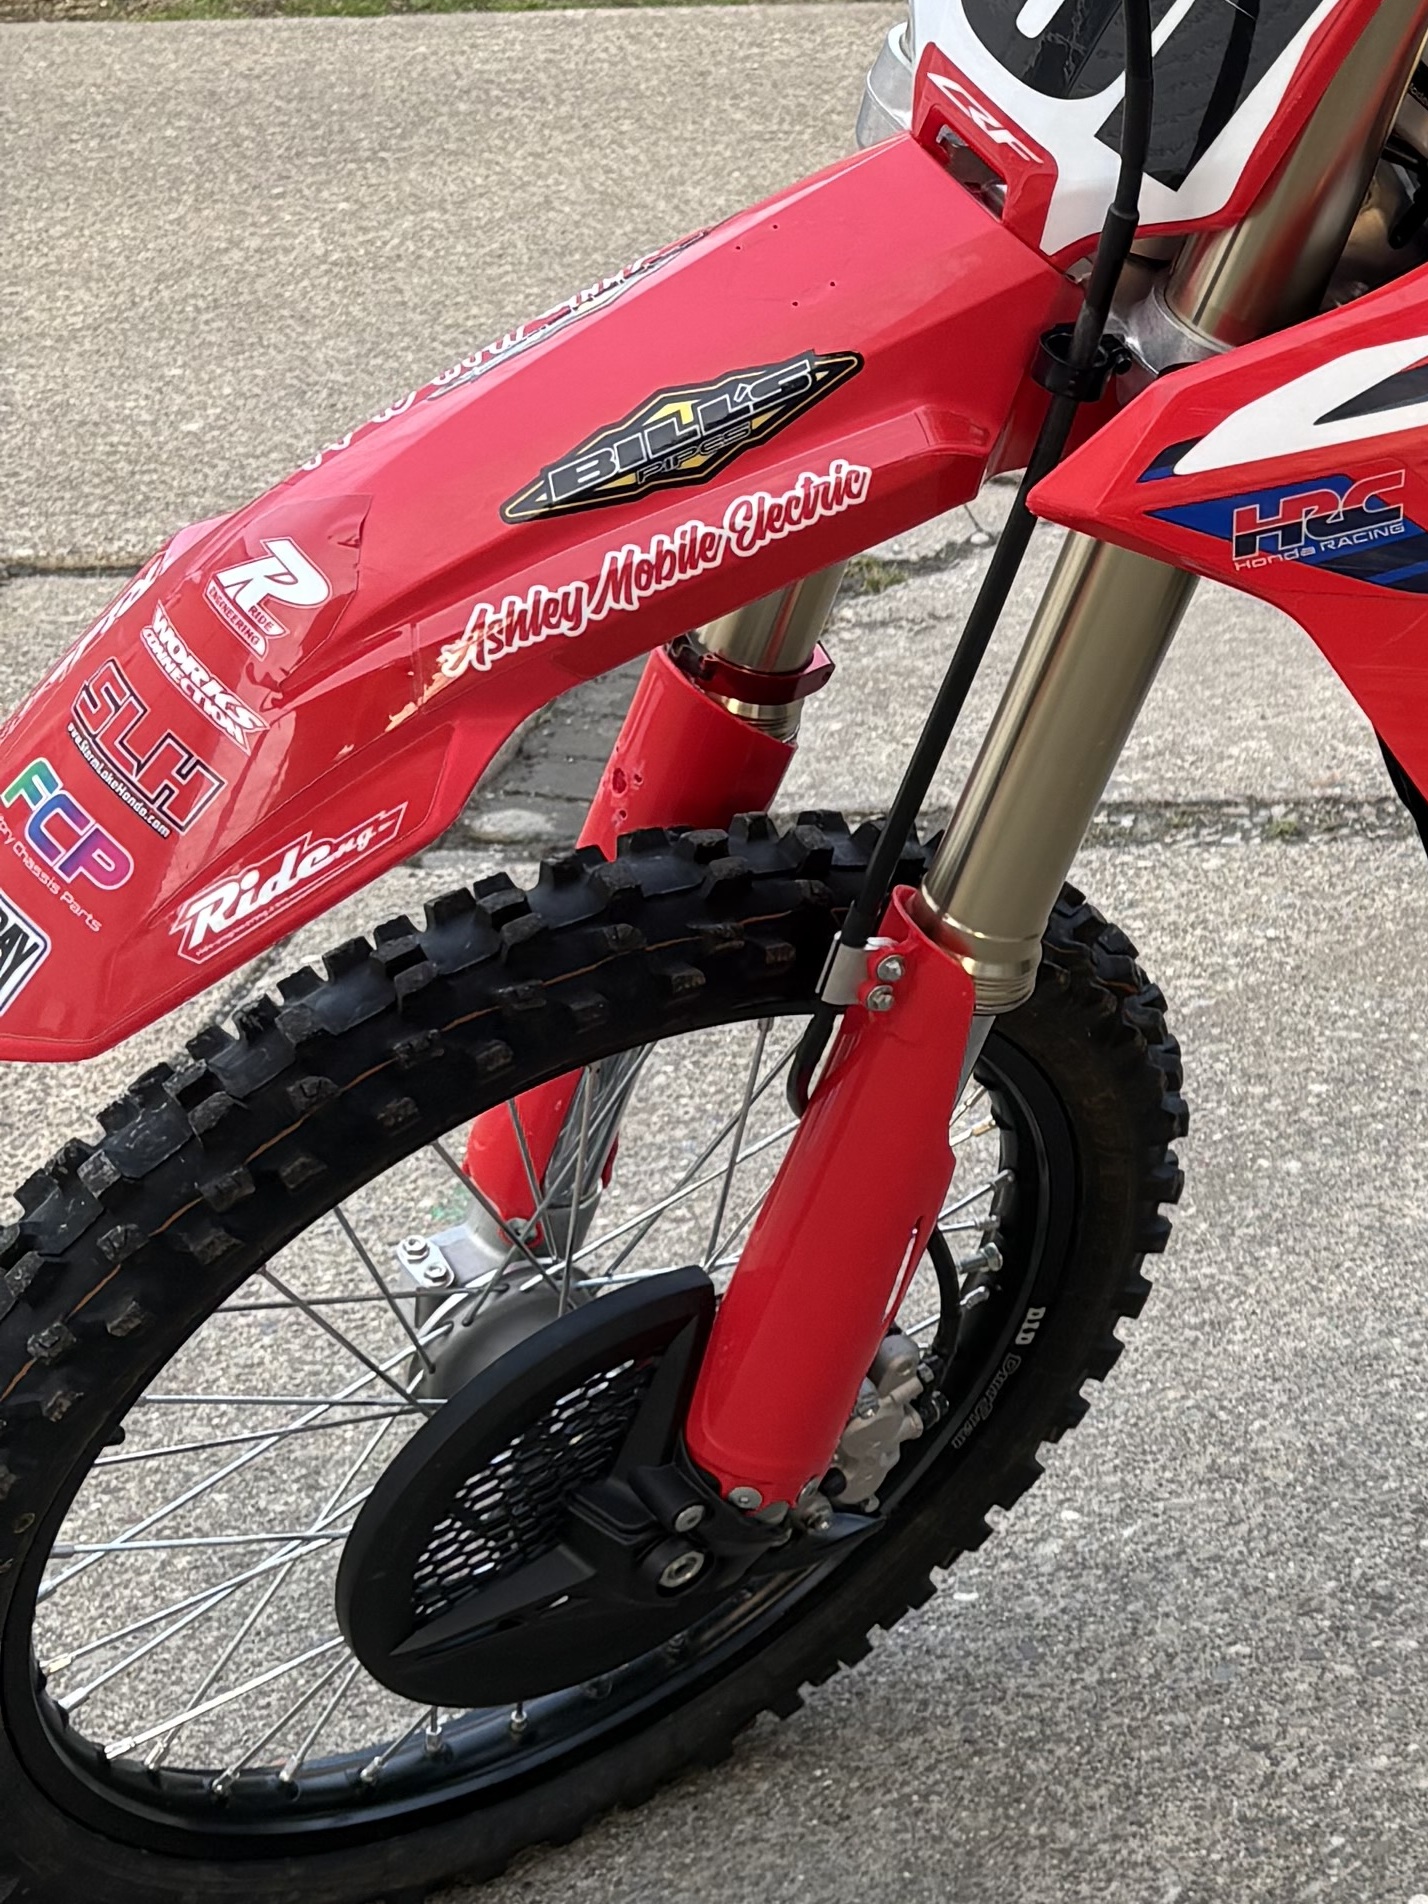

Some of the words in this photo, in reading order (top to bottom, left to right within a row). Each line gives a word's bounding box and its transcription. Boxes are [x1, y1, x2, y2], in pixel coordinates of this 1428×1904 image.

[927, 72, 1044, 164] CRF
[547, 359, 814, 503] BILL'S
[637, 421, 753, 485] PIPES
[1233, 469, 1405, 560] HRC
[1320, 523, 1405, 552] RACING
[441, 583, 590, 672] Ashley
[587, 520, 725, 620] Mobile
[722, 459, 873, 557] Electric
[208, 585, 261, 647] ENGINEERING
[247, 604, 277, 633] RIDE
[142, 626, 250, 754] CONNECTION
[153, 600, 270, 731] WORKS
[1, 756, 135, 891] FCP
[13, 840, 61, 895] Chassis
[60, 890, 102, 933] Parts
[1015, 1306, 1046, 1345] DID
